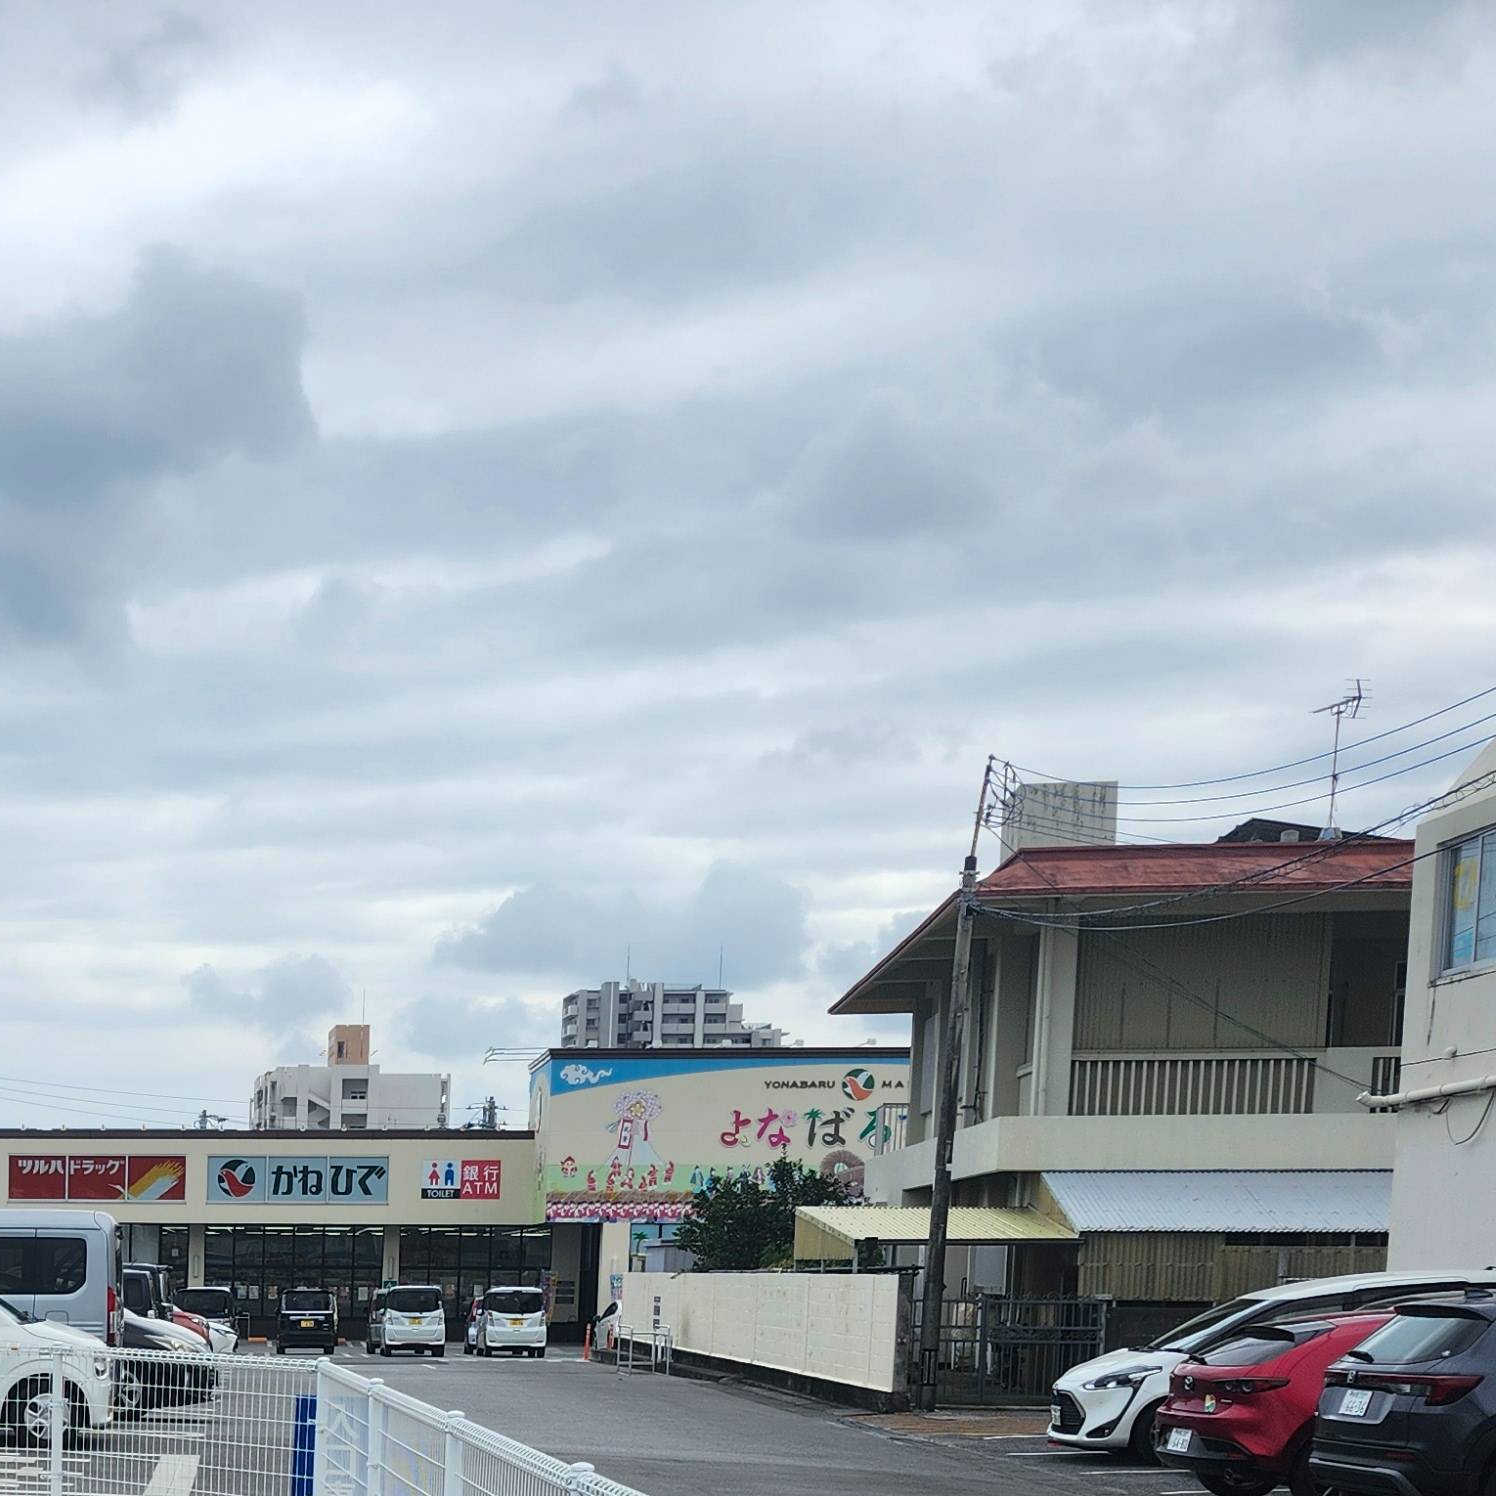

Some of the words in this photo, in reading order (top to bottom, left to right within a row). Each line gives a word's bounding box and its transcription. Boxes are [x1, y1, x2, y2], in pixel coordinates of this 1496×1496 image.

[764, 1079, 836, 1090] YONABARU
[881, 1079, 910, 1089] MA
[462, 1164, 500, 1182] 銀行
[271, 1164, 386, 1197] かねひで
[425, 1189, 455, 1199] TOILET
[462, 1182, 499, 1195] ATM
